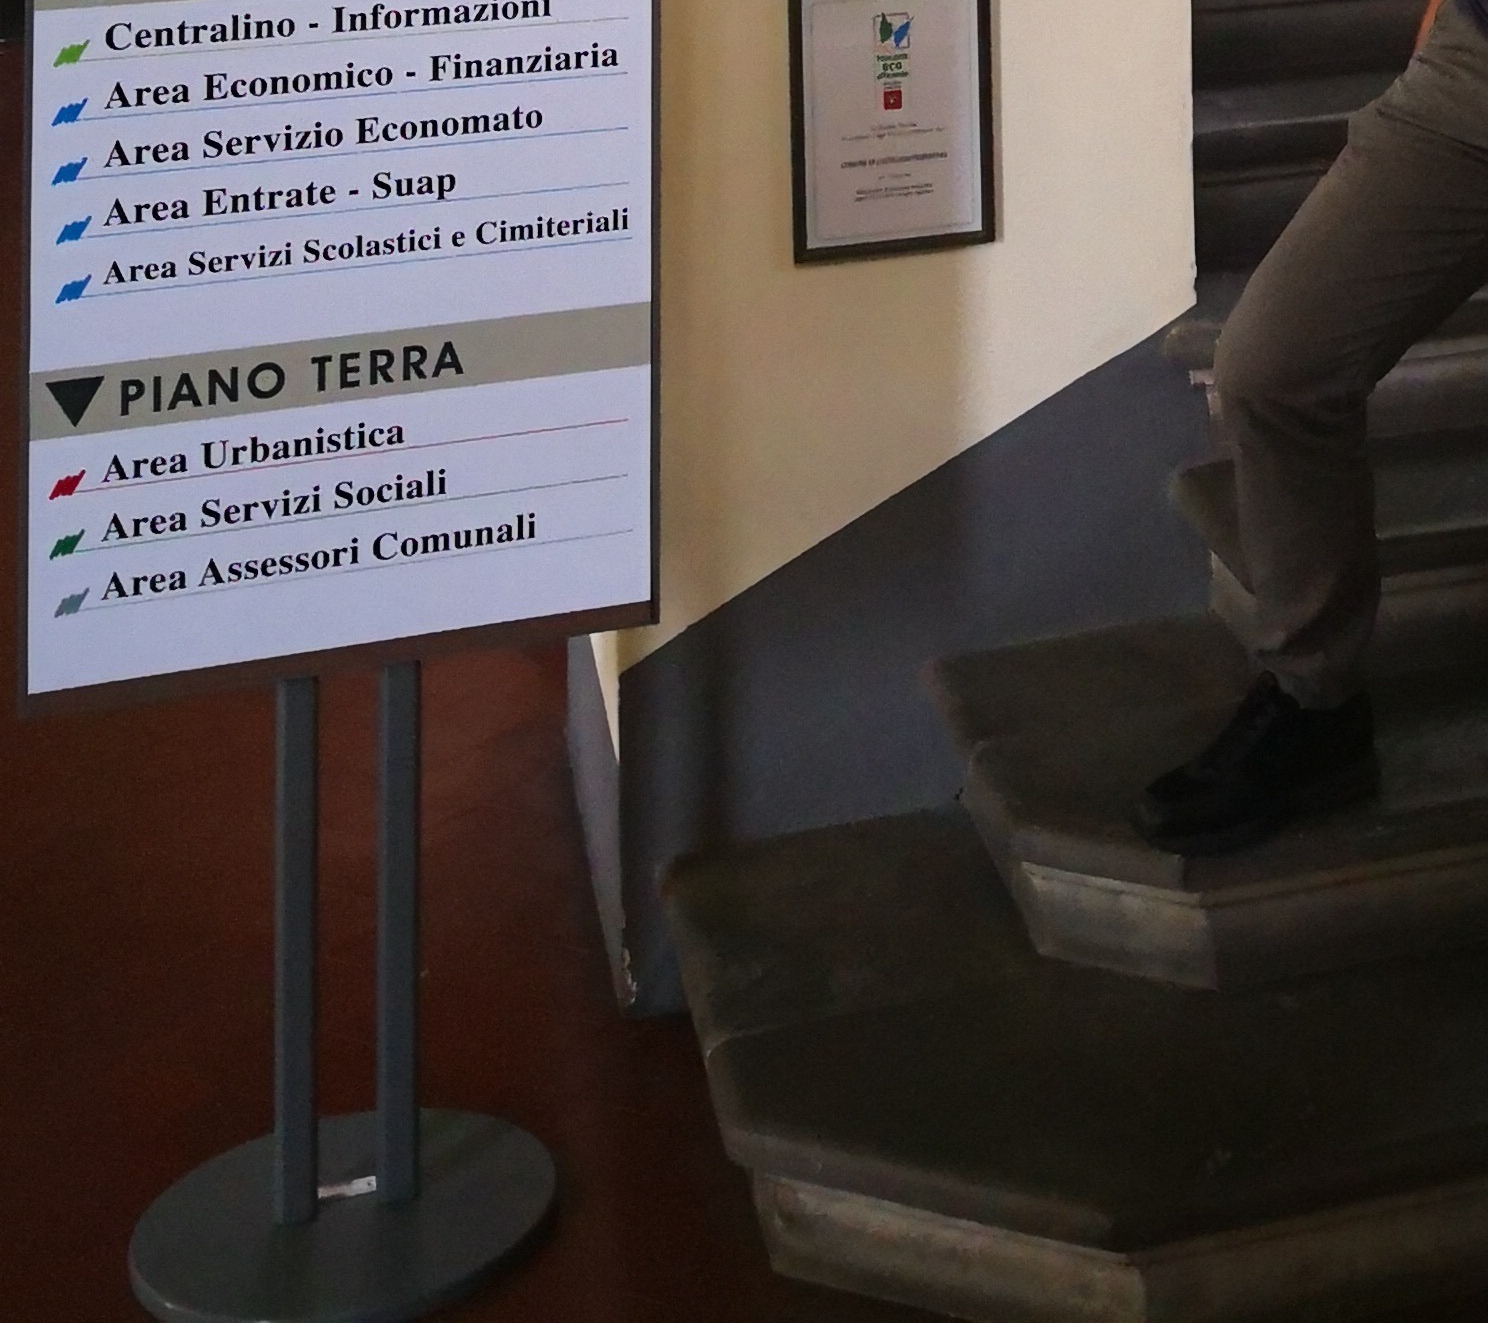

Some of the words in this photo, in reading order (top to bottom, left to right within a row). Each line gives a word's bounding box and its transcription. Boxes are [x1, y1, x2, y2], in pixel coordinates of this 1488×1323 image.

[105, 13, 296, 51] Centralino
[104, 81, 190, 110] Area
[203, 62, 393, 101] Economico
[429, 42, 619, 82] Finanziaria
[104, 139, 190, 168] Area
[202, 121, 344, 159] Servizio
[355, 106, 543, 145] Economato
[103, 198, 190, 227] Area
[202, 181, 336, 217] Entrate
[372, 171, 456, 201] Suap
[103, 260, 177, 285] Area
[188, 242, 292, 276] Servizi
[303, 226, 442, 264] Scolastici
[451, 231, 466, 248] e
[475, 207, 629, 245] Cimiteriali
[119, 361, 286, 417] PIANO
[310, 340, 465, 393] TERRA
[101, 453, 188, 483] Area
[200, 422, 405, 469] Urbanistica
[100, 512, 187, 543] Area
[200, 485, 321, 528] Servizi
[334, 468, 447, 509] Sociali
[101, 570, 187, 601] Area
[198, 537, 359, 587] Assessori
[372, 512, 536, 561] Comunali
